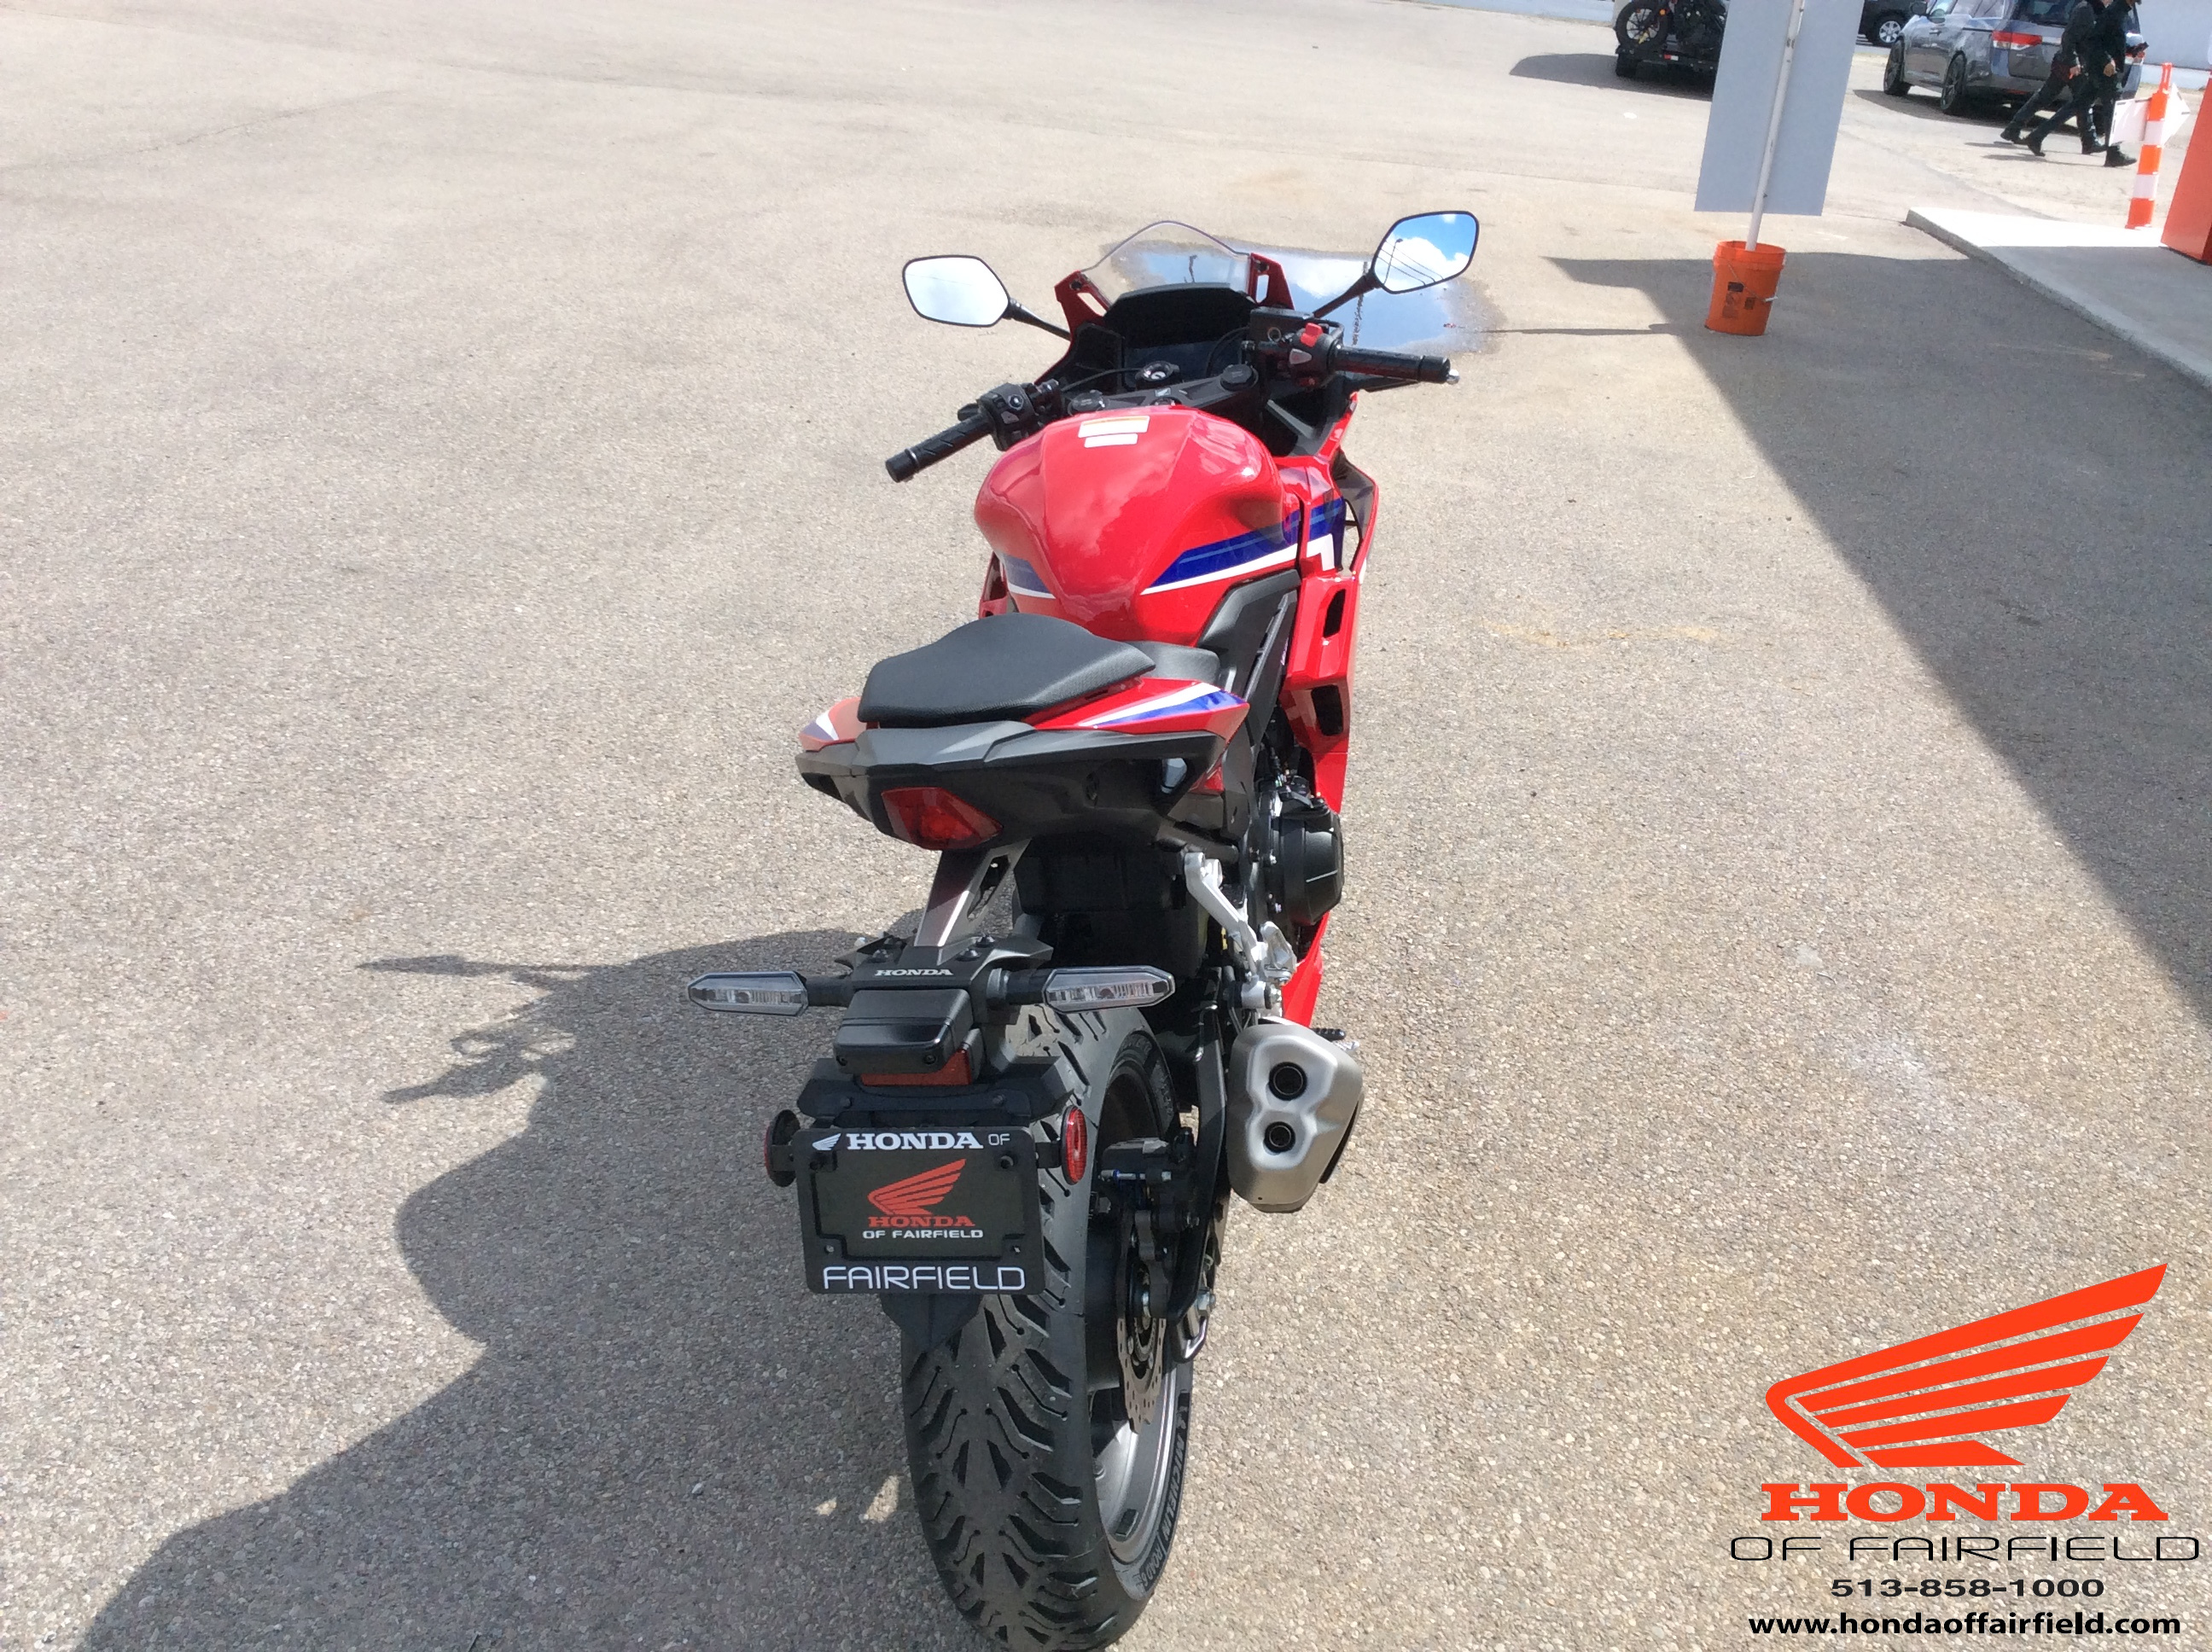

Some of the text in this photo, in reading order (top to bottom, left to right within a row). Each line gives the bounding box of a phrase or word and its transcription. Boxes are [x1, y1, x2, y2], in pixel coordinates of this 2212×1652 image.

[874, 969, 954, 977] HONDA
[847, 1132, 1010, 1150] HONDA OF
[868, 1216, 975, 1228] HONDA
[863, 1230, 984, 1239] OF FAIRFIELD
[824, 1265, 1026, 1290] FAIRFIELD
[1161, 1434, 1185, 1541] MICHELIN
